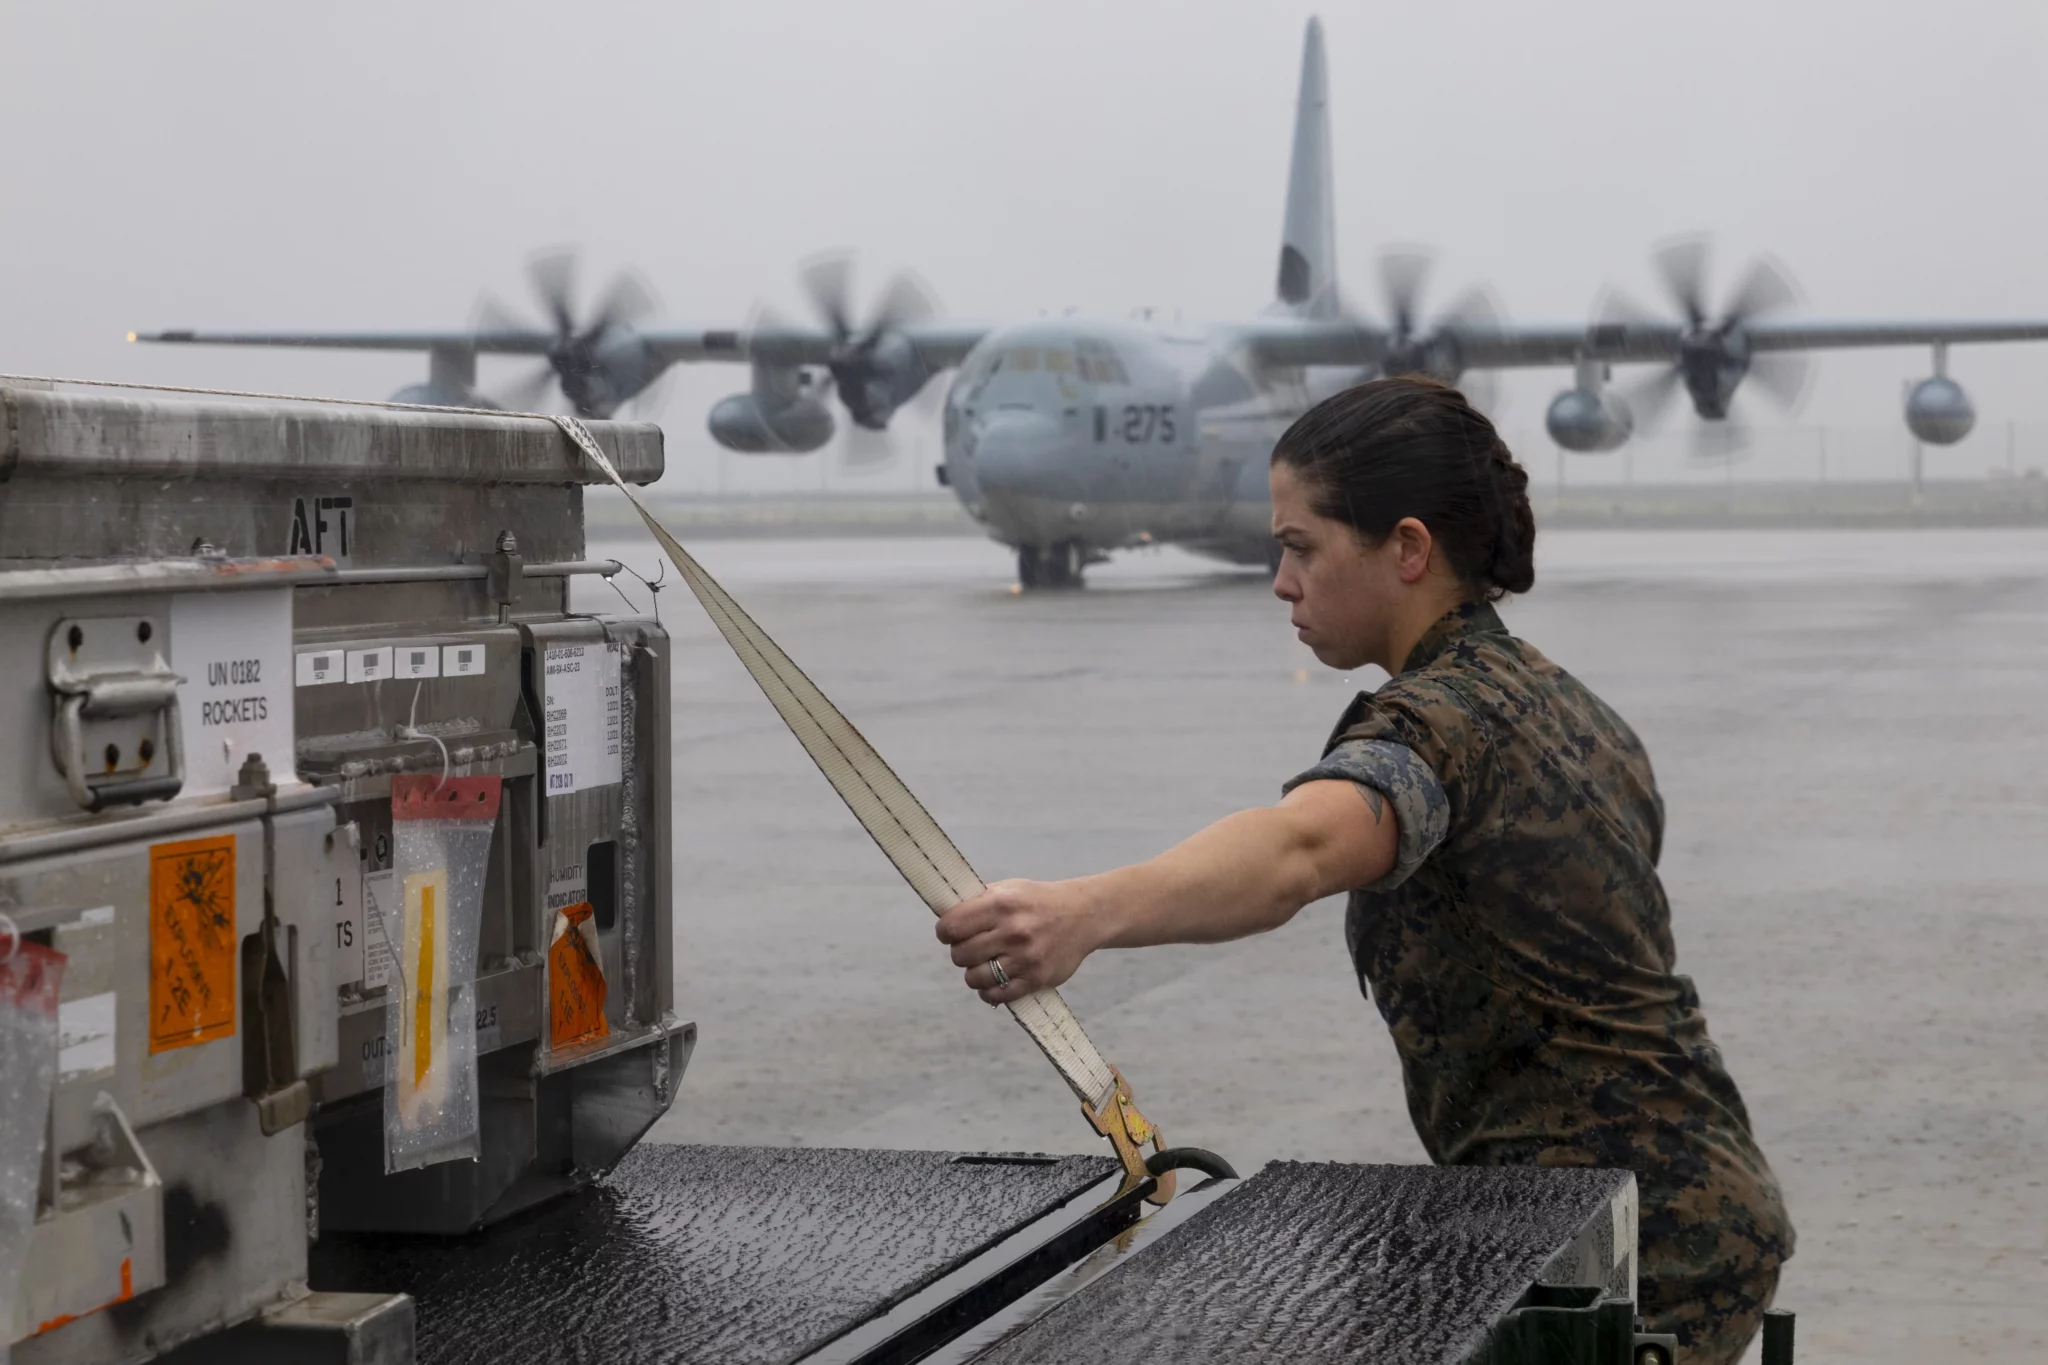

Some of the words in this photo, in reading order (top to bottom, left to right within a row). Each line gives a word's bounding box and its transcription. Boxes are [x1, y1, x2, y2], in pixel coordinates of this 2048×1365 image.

[290, 497, 352, 556] AFT
[208, 661, 227, 687] UN
[231, 659, 260, 684] 0182
[202, 696, 267, 726] ROCKETS
[550, 865, 583, 883] HUMIDITY
[547, 889, 586, 909] INDICATOR
[476, 1006, 497, 1029] 22.5
